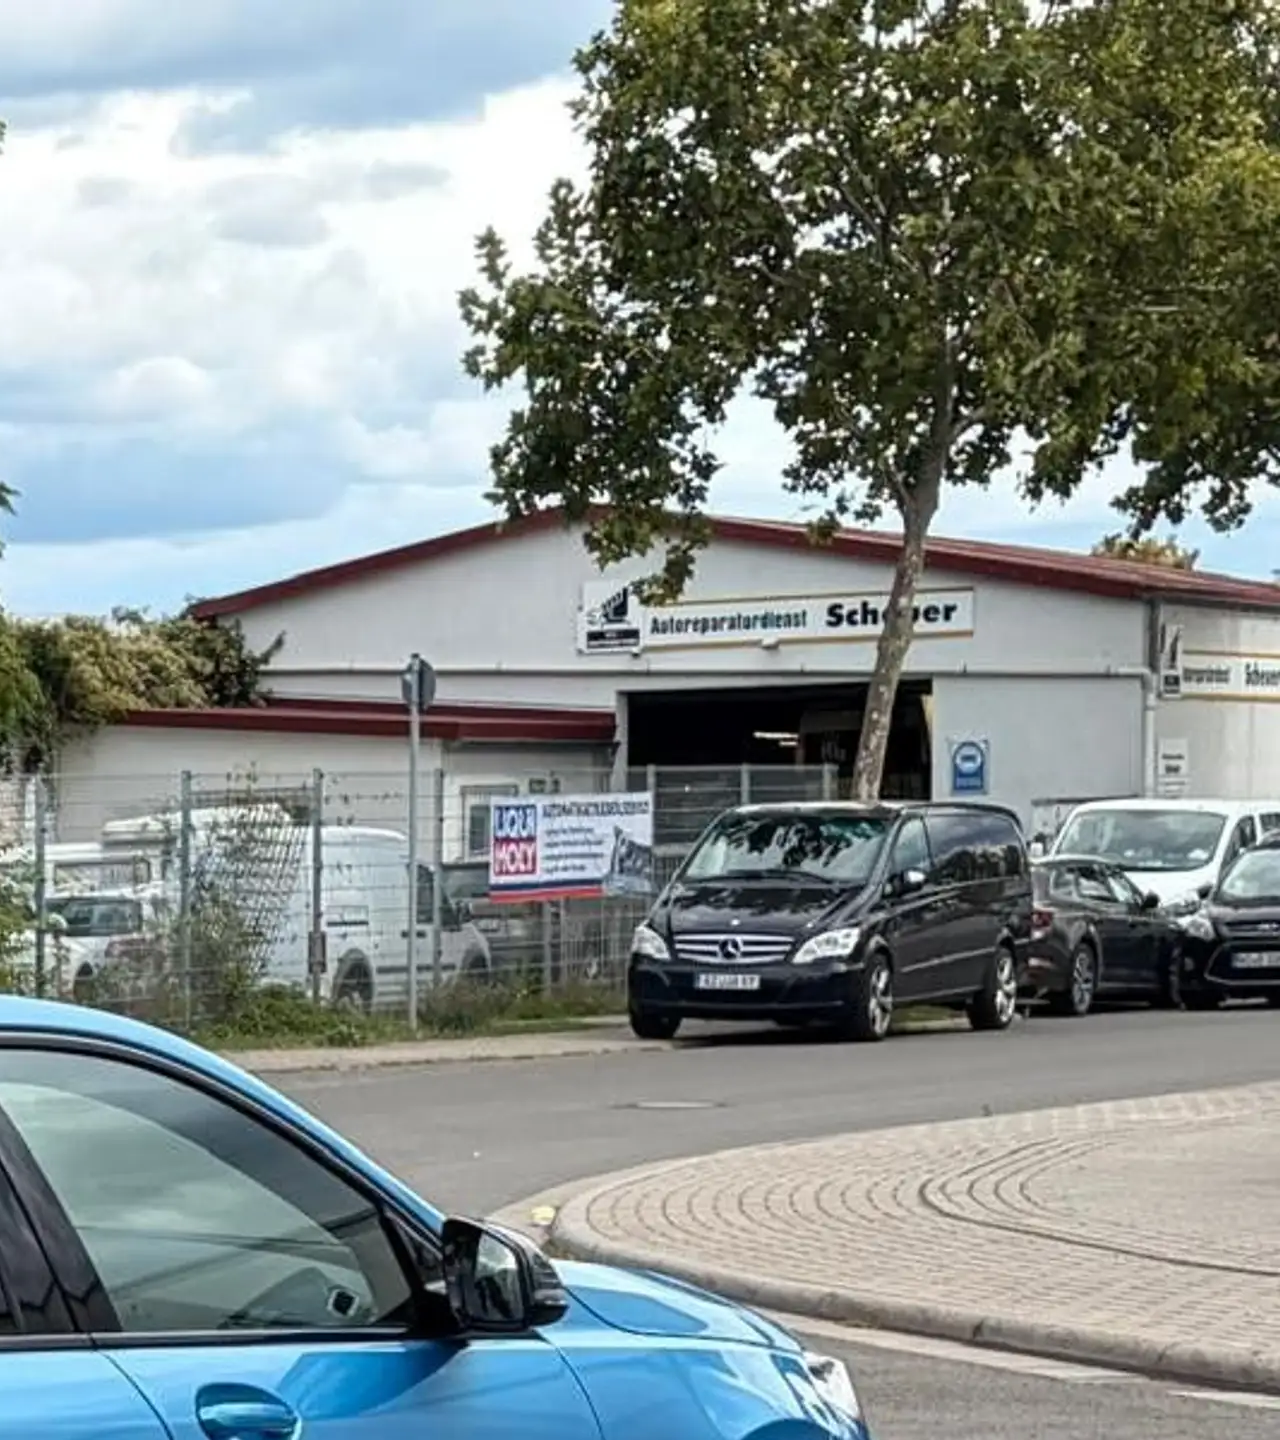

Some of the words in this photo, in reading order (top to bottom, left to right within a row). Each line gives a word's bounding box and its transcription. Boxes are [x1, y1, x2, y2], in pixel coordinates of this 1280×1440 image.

[649, 608, 808, 636] Autoreparaturdienst
[825, 600, 958, 628] Scher
[494, 841, 536, 873] MOLY
